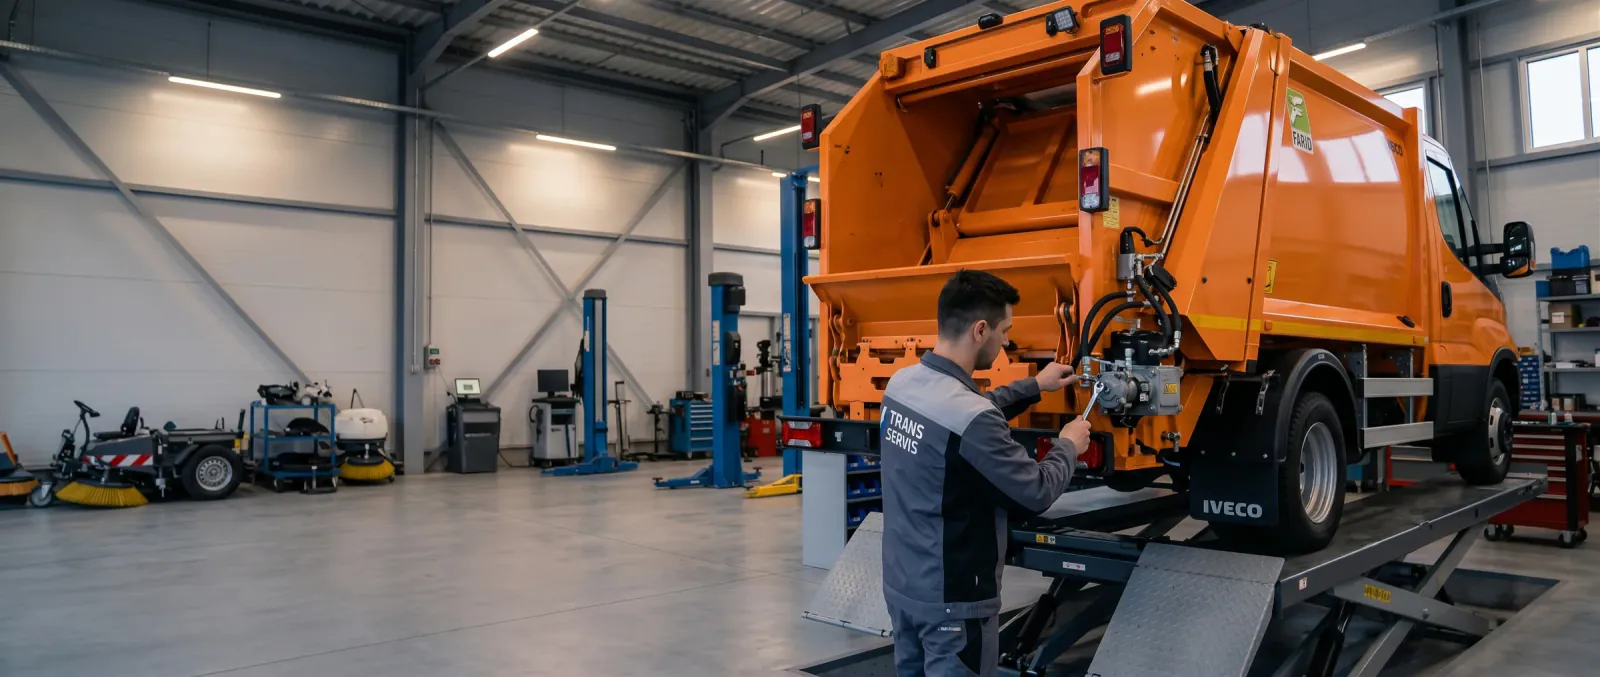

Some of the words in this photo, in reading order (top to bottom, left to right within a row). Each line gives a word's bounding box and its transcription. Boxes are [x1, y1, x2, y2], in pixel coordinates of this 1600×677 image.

[1293, 131, 1312, 151] FARID
[890, 410, 925, 440] TRANS
[885, 427, 919, 455] SERVIS
[1203, 499, 1263, 518] IVECO
